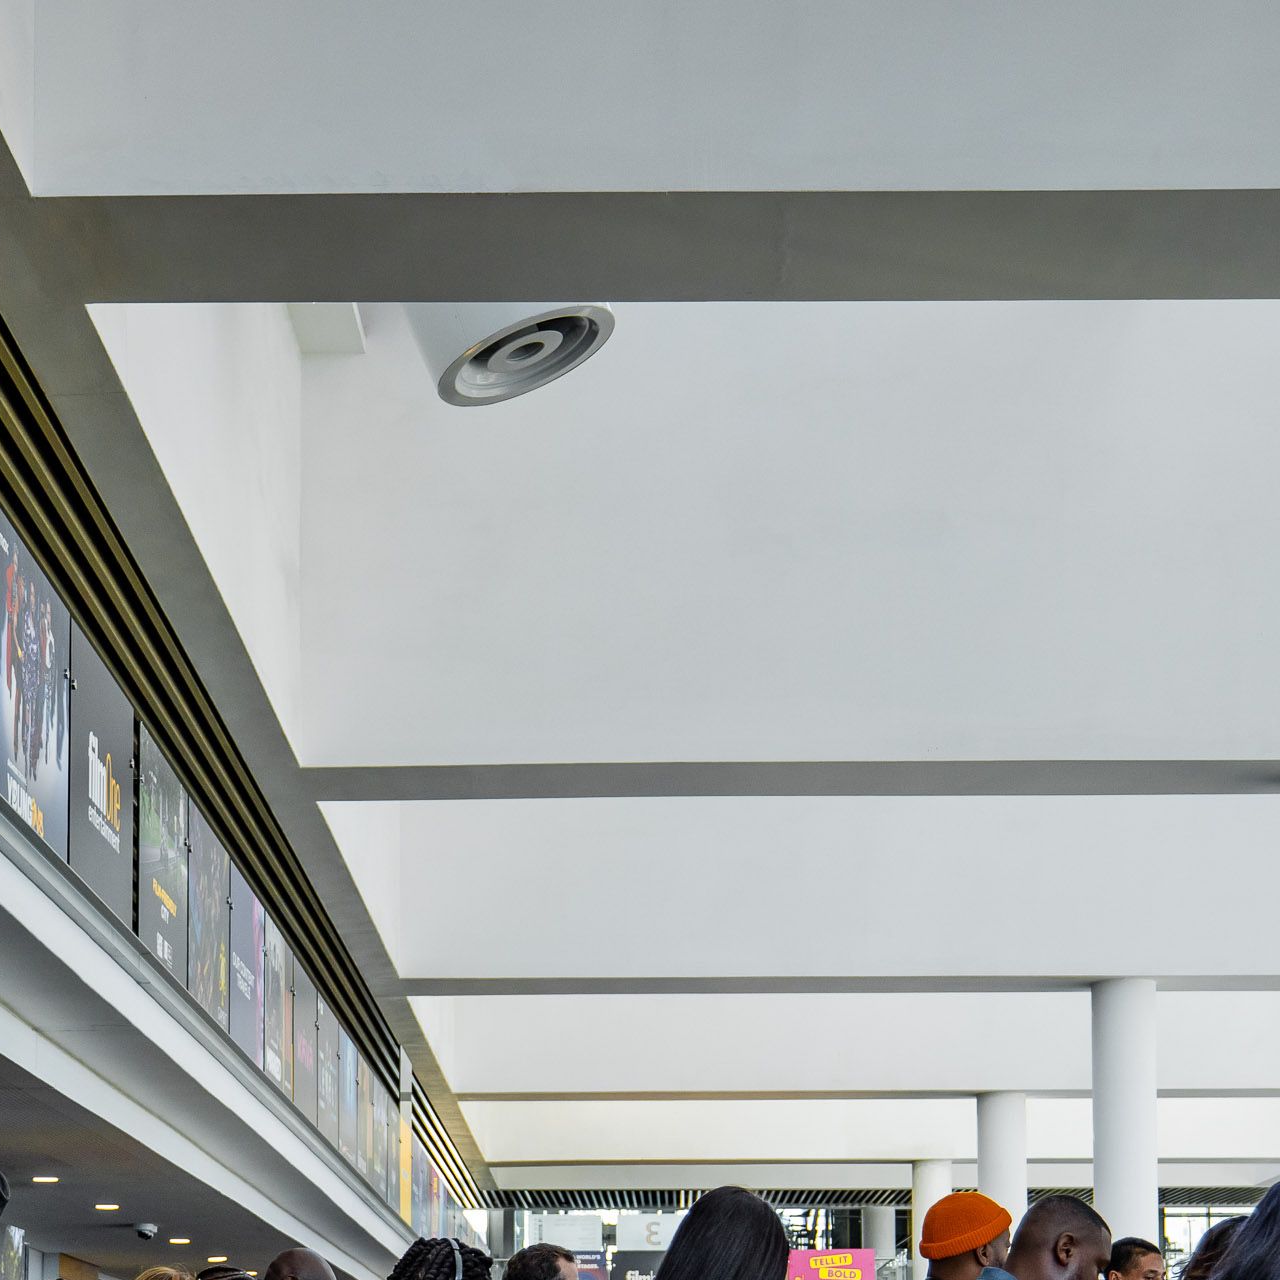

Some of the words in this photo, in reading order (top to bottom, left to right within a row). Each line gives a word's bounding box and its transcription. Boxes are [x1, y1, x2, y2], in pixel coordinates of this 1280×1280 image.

[88, 804, 120, 854] entertainment
[813, 1257, 835, 1267] TELL
[839, 1255, 848, 1264] IT
[827, 1269, 857, 1279] BOLD
